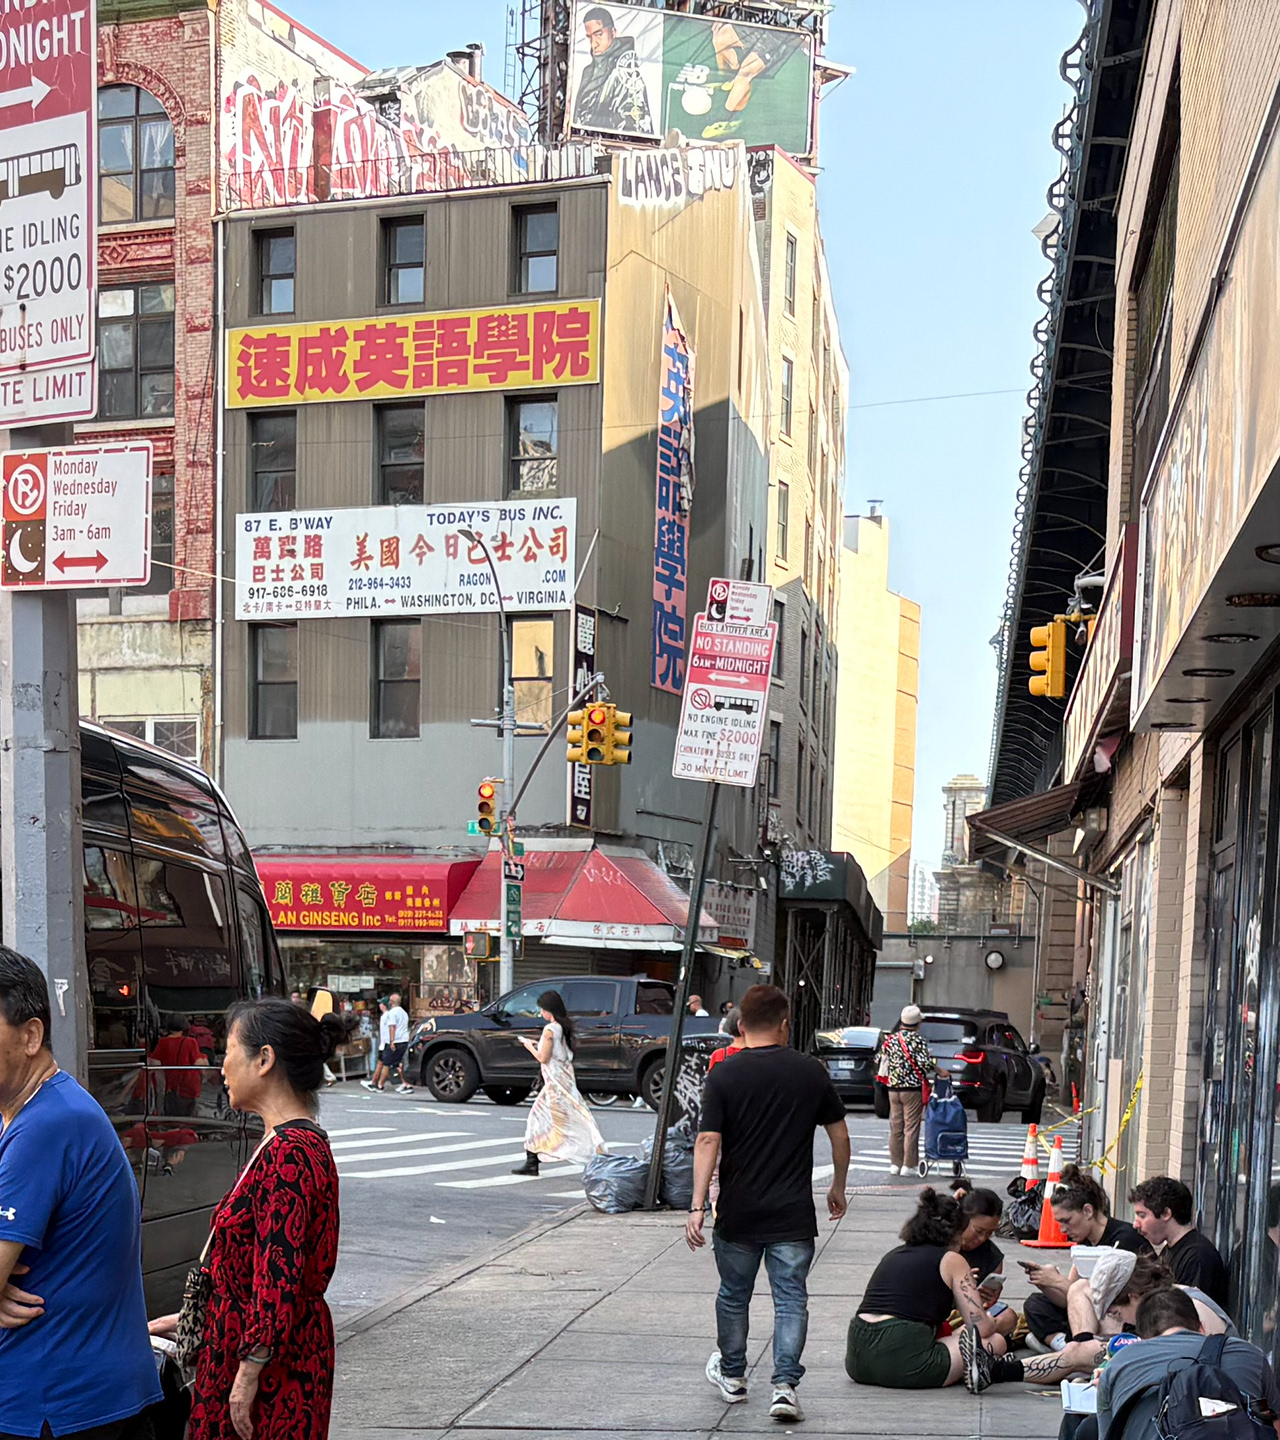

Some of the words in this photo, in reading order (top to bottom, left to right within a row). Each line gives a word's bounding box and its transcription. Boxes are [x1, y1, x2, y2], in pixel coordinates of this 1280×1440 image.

[23, 213, 80, 249] IDLING
[4, 253, 82, 301] $2000
[0, 321, 43, 354] BUSES
[51, 314, 85, 344] ONLY
[237, 307, 591, 400] 速成英語學院
[33, 371, 87, 402] LIMIT
[53, 459, 98, 478] Monday
[53, 479, 118, 497] Wednesday
[53, 500, 87, 518] Friday
[427, 510, 490, 526] TODAY'S
[499, 508, 526, 521] BUS
[532, 505, 563, 521] INC.
[53, 526, 77, 541] 3am
[87, 524, 111, 540] 6am
[245, 520, 261, 532] 87
[269, 519, 282, 531] E.
[289, 516, 333, 531] B'WAY
[253, 563, 324, 582] 巴士公司
[346, 597, 381, 610] PHILA.
[401, 592, 476, 608] WASHINGTON,
[517, 590, 566, 604] VIRGINIA
[750, 627, 769, 637] AREA
[696, 636, 711, 650] NO
[714, 639, 769, 657] STANDING
[692, 655, 769, 674] 6AM-MIDNIGHT
[688, 713, 698, 722] NO
[700, 715, 729, 727] ENGINE
[731, 718, 756, 729] IDLING
[684, 729, 698, 738] MAX
[720, 728, 756, 745] $2000
[681, 763, 692, 772] 30
[728, 769, 748, 779] LIMIT
[261, 880, 377, 908] 蘭雜貨店
[300, 911, 359, 926] GINSENG
[362, 912, 381, 926] Inc
